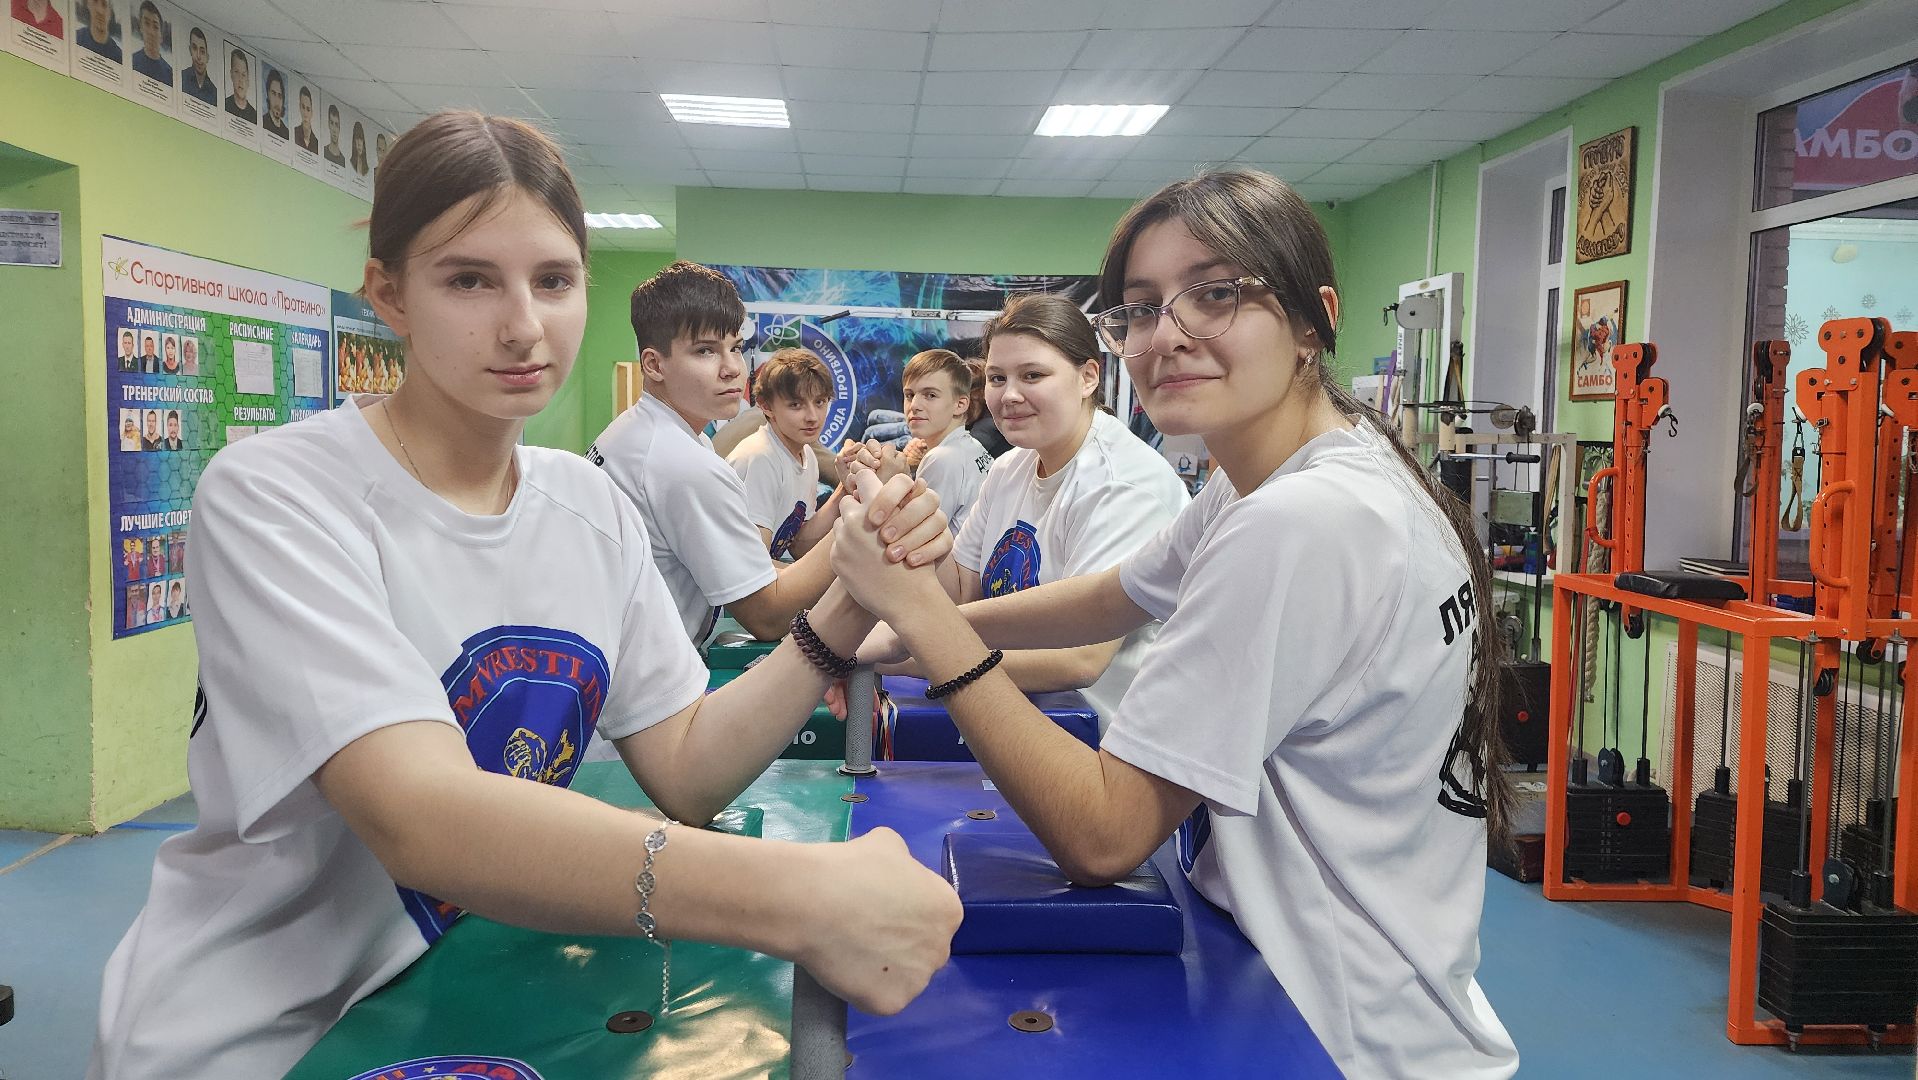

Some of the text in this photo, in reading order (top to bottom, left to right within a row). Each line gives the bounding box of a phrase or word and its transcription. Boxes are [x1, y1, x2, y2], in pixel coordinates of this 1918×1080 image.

[131, 261, 327, 317] Спортивная школа «Протвино»
[127, 306, 206, 334] АДМИНИСТРАЦИЯ
[229, 321, 274, 341] РАСПИСАНИЕ
[291, 331, 322, 348] КАЛЕНДАРЬ
[813, 339, 848, 400] ПРОТВИНО
[1577, 374, 1613, 388] САМБО
[122, 384, 214, 404] ТРЕНЕРСКИЙ СОСТАВ
[233, 406, 276, 422] РЕЗУЛЬТАТЫ
[119, 512, 164, 532] ЛУЧШИЕ
